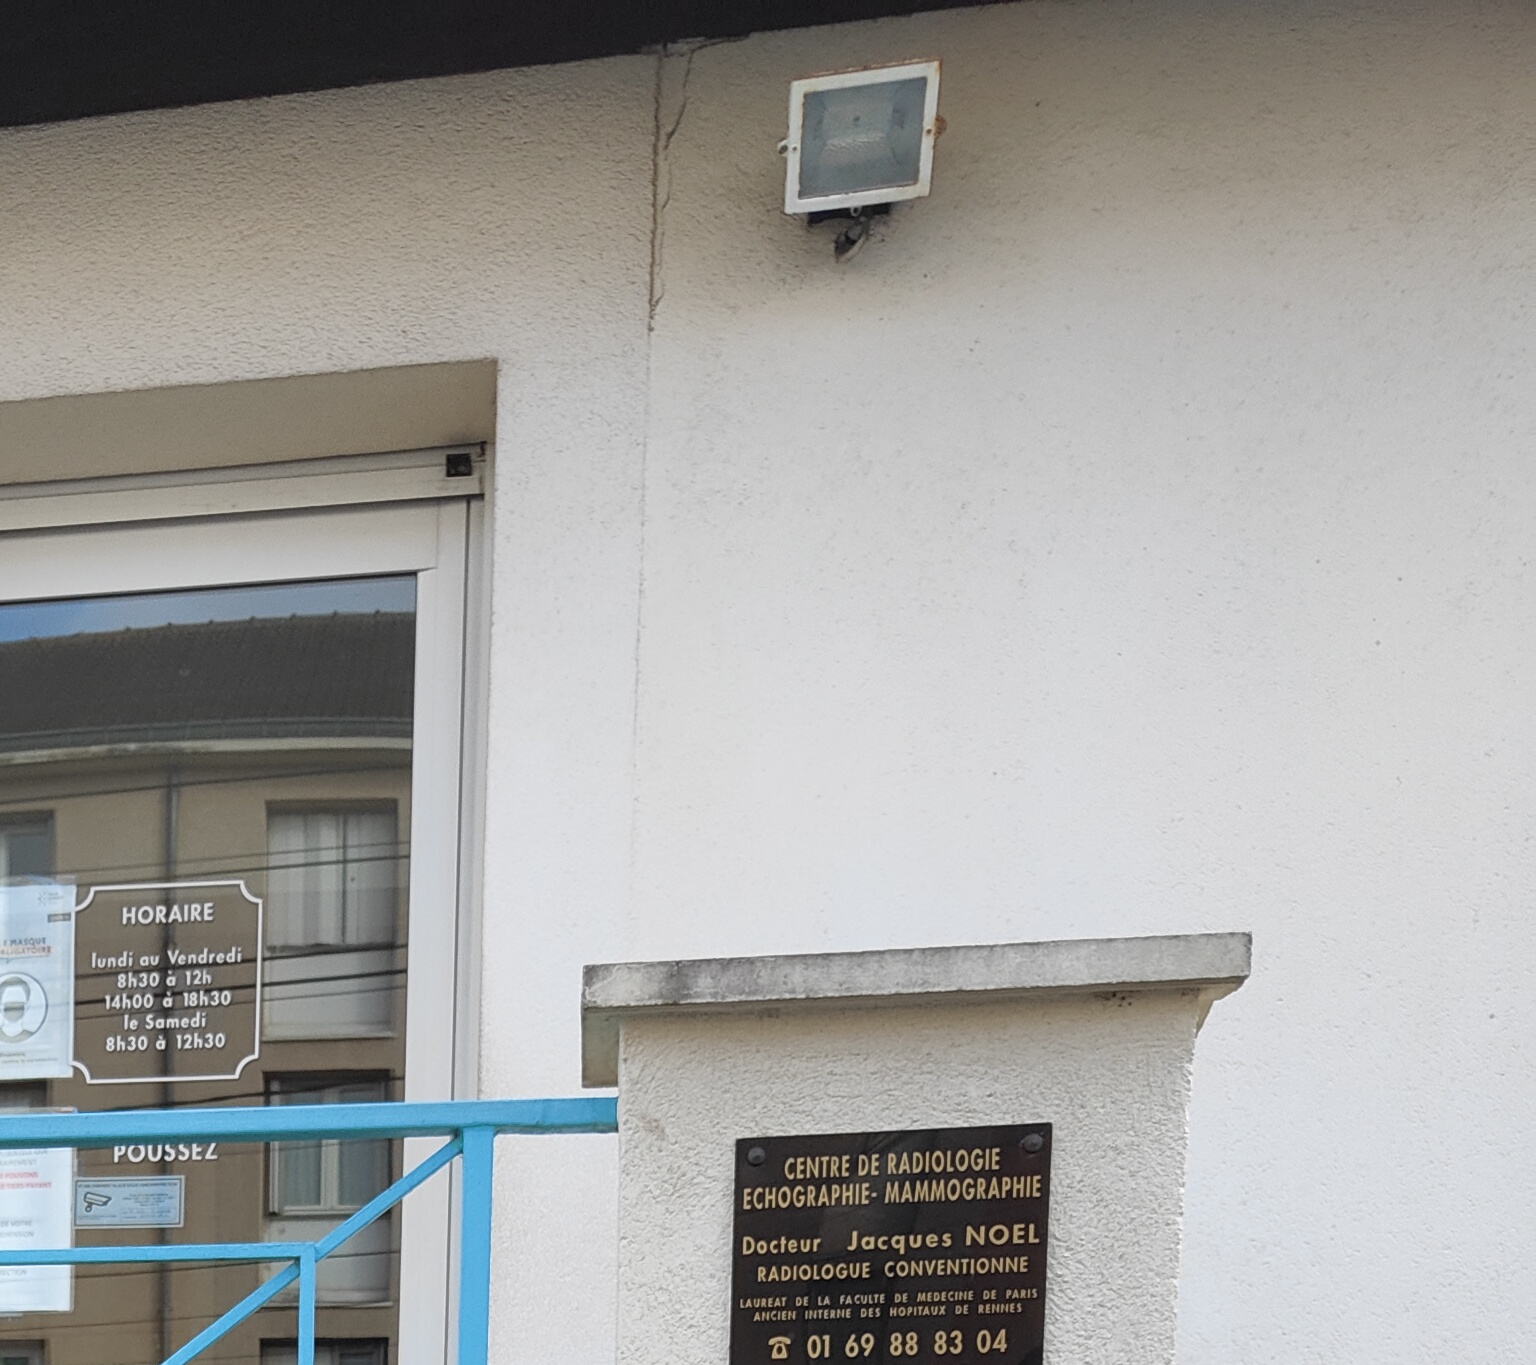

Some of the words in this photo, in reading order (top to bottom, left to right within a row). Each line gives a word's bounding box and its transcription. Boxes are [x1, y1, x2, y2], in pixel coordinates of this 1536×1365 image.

[122, 903, 214, 925] HORAIRE
[10, 937, 46, 946] MASQUE
[91, 951, 133, 968] lundi
[140, 955, 160, 967] au
[167, 947, 242, 965] Vendredi
[117, 972, 159, 989] 8h30
[166, 971, 176, 987] à
[185, 970, 212, 986] 12h
[105, 994, 154, 1010] 14h00
[163, 992, 173, 1008] à
[183, 990, 231, 1007] 18h30
[124, 1014, 138, 1030] le
[145, 1012, 207, 1029] Samedi
[106, 1035, 148, 1052] 8h30
[156, 1035, 166, 1050] à
[176, 1033, 226, 1049] 12h30
[113, 1143, 218, 1163] POUSSEZ
[784, 1155, 850, 1180] CENTRE
[857, 1153, 880, 1176] DE
[887, 1148, 1001, 1175] RADIOLOGIE
[743, 1182, 877, 1210] ECHOGRAPHIE-
[885, 1175, 1042, 1203] MAMMOGRAPHIE
[742, 1235, 821, 1255] Docteur
[847, 1230, 953, 1254] Jacques
[965, 1223, 1041, 1246] NOEL
[757, 1262, 871, 1282] RADIOLOGUE
[884, 1256, 1029, 1278] CONVENTIONNE
[740, 1296, 788, 1309] LAUREAT
[795, 1296, 809, 1307] DE
[817, 1295, 831, 1306] LA
[840, 1293, 886, 1305] FACULTE
[894, 1292, 909, 1303] DE
[916, 1290, 974, 1303] MEDECINE
[983, 1290, 997, 1300] DE
[1006, 1288, 1038, 1299] PARIS
[753, 1310, 797, 1322] ANCIEN
[805, 1308, 851, 1319] INTERNE
[860, 1307, 881, 1318] DES
[889, 1305, 946, 1317] HOPITAUX
[955, 1304, 969, 1315] DE
[978, 1303, 1023, 1314] RENNES
[807, 1335, 831, 1359] 01
[845, 1333, 875, 1358] 69
[889, 1331, 919, 1356] 88
[934, 1330, 963, 1355] 83
[976, 1329, 1008, 1353] 04
